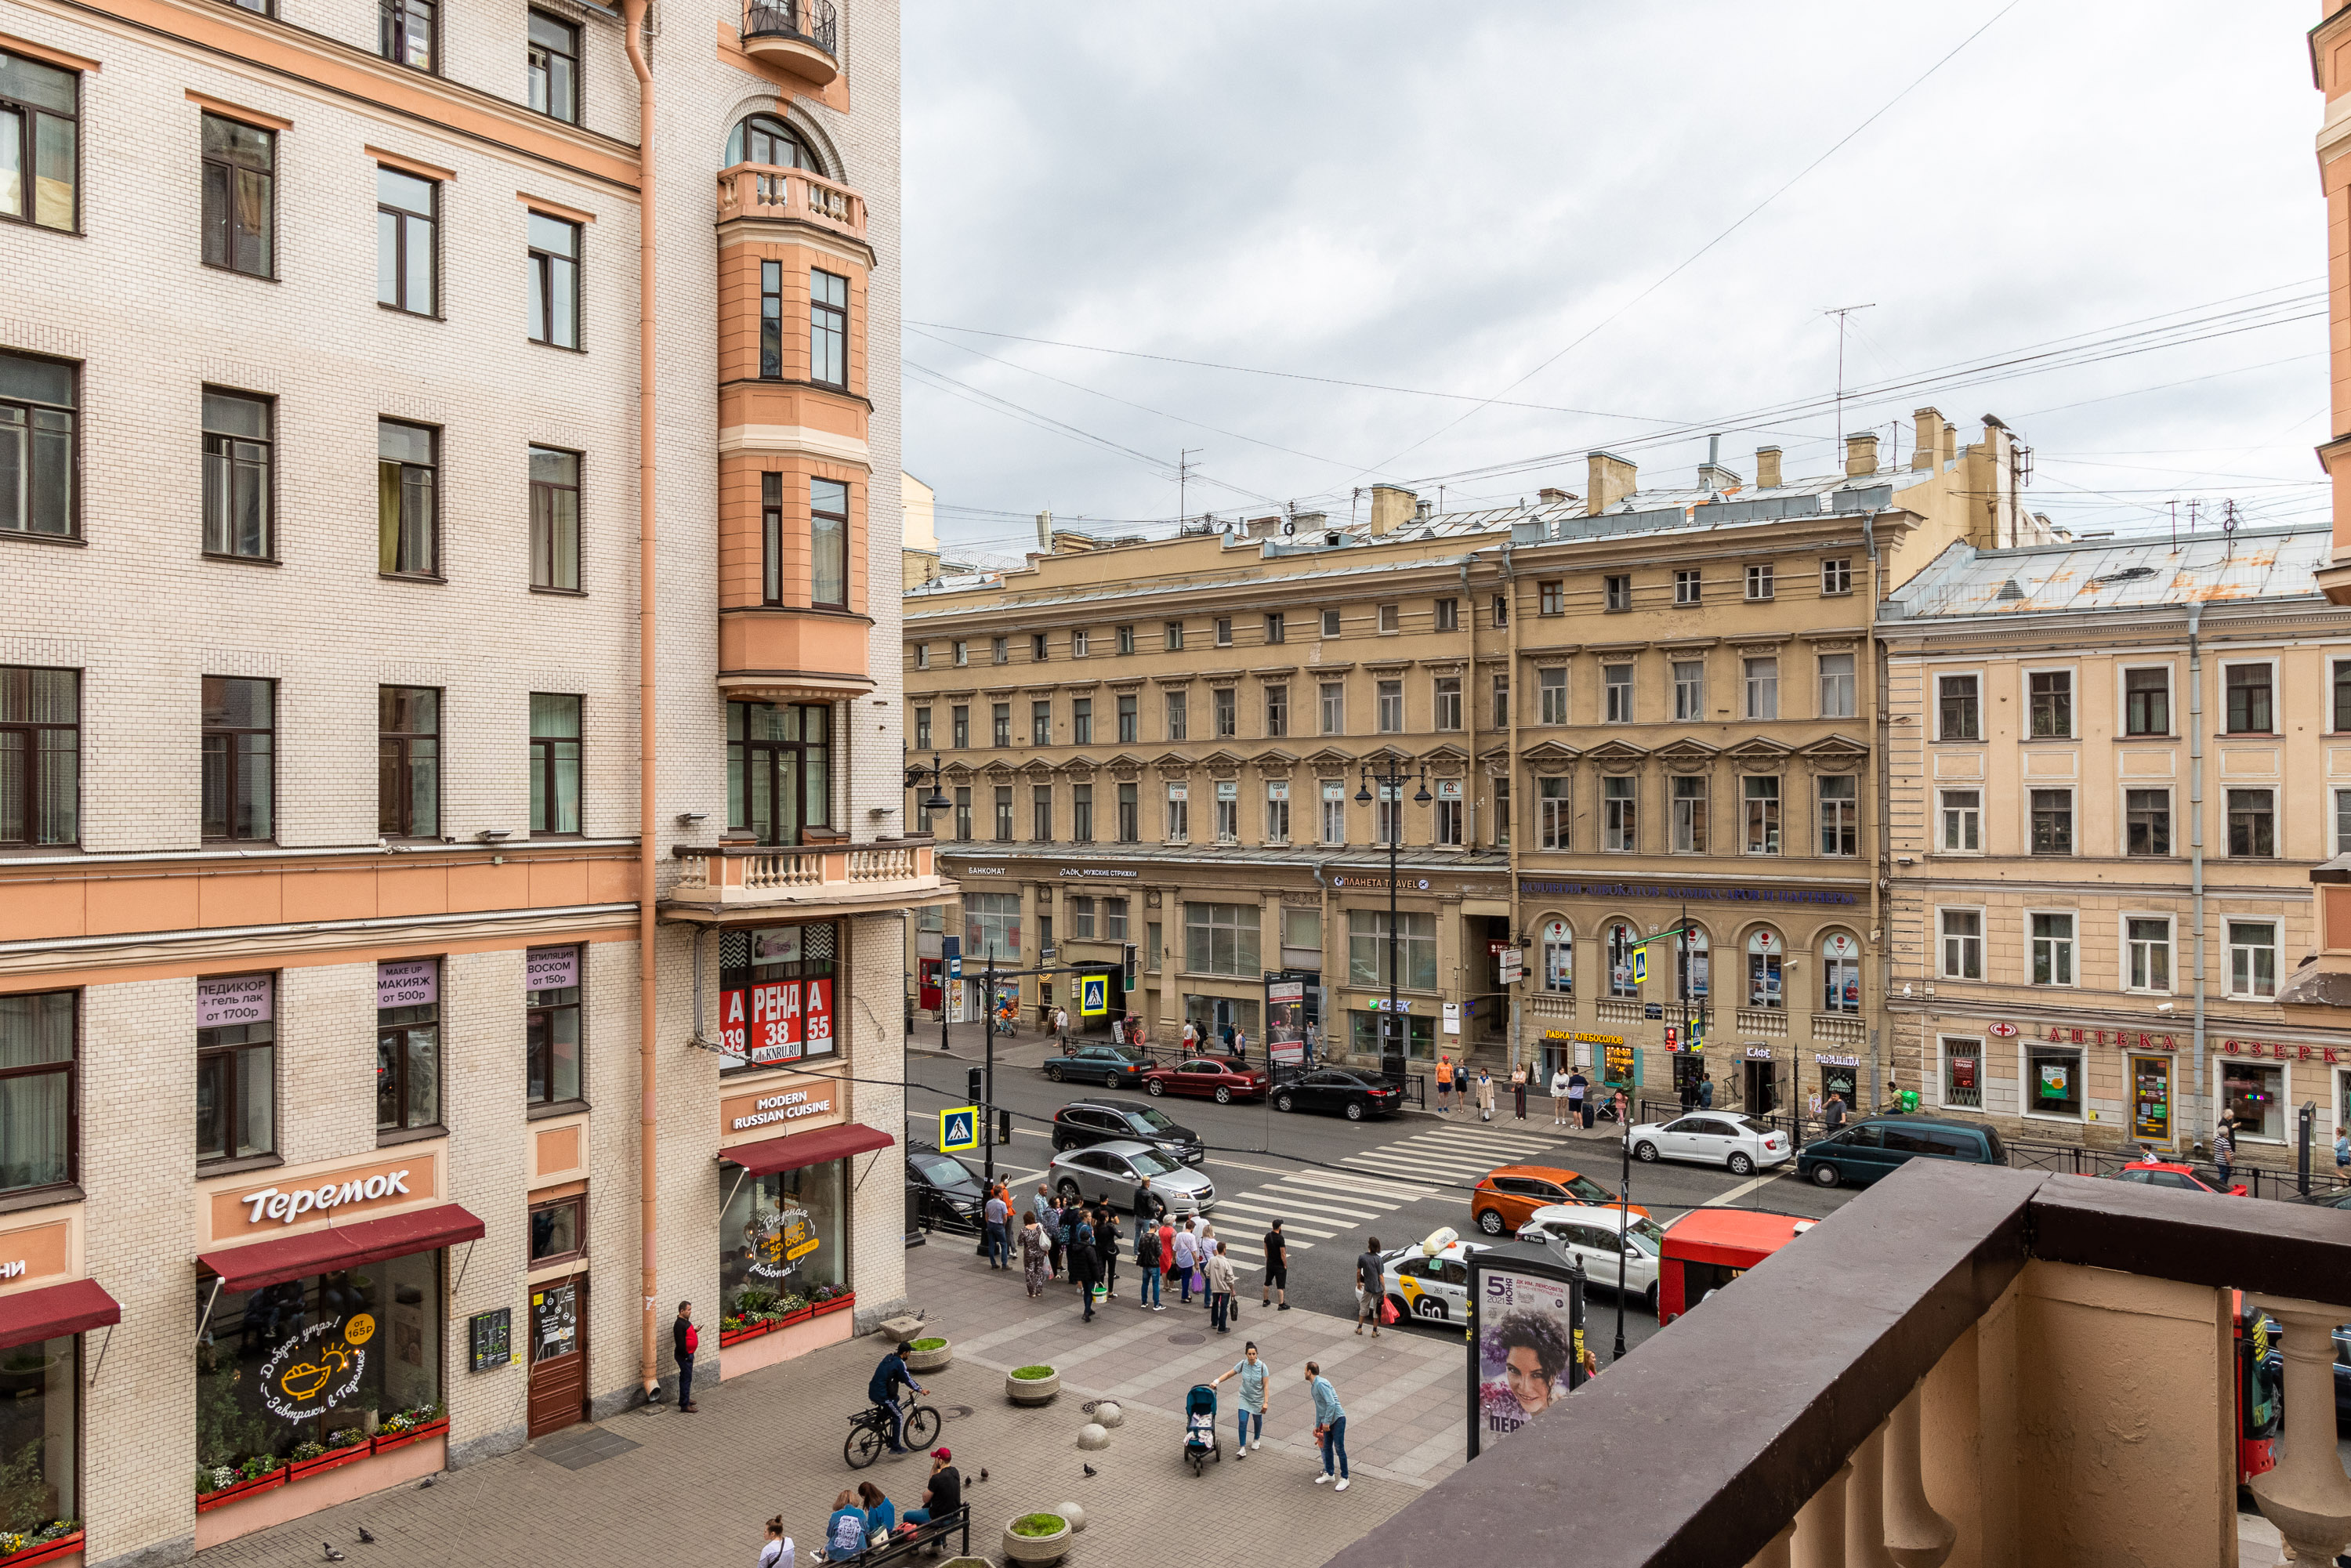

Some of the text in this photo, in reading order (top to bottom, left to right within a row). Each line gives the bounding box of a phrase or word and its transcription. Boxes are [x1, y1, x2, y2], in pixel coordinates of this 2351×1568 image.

[969, 867, 1005, 875] БАНКОМАТ
[1344, 878, 1418, 889] ПЛАНЕТА TAVEL
[1521, 882, 1581, 894] КОЛЛЕГИЯ
[1585, 883, 1659, 897] АДВОКАТОВ
[1763, 889, 1773, 901] И
[527, 951, 574, 962] ДЕПИЛЯЦИЯ
[386, 967, 409, 976] MAKE
[527, 961, 571, 973] ВОСКОМ
[378, 976, 430, 990] МАКИЯЖ
[545, 974, 567, 984] 150р
[198, 980, 266, 996] ПЕДИКЮР
[212, 996, 239, 1006] гель
[242, 994, 263, 1003] лак
[397, 990, 426, 1001] 500р
[206, 1008, 259, 1021] от 1700р
[765, 1021, 788, 1045] 38
[808, 1016, 829, 1040] 55
[1545, 1030, 1624, 1045] ЛАВКА ХЛЕБОСОЛОВ
[2049, 1027, 2175, 1050] АПТЕКА
[766, 1044, 799, 1060] KNRU.RU
[1665, 1040, 1677, 1052] 23
[1746, 1047, 1771, 1058] КАФЕ
[2224, 1040, 2351, 1063] ОЗЕРК
[1815, 1054, 1860, 1066] ПИРАМИДА
[756, 1091, 807, 1110] MODERN
[734, 1099, 830, 1129] RUSSIAN CUISINE
[241, 1169, 410, 1223] Теремок
[1487, 1276, 1505, 1296] 5
[1535, 1282, 1563, 1293] ЛЕНСОВЕТА
[1487, 1295, 1505, 1304] 2021
[1419, 1298, 1442, 1320] Go
[260, 1335, 299, 1378] Доброе
[1490, 1415, 1525, 1433] ПЕР
